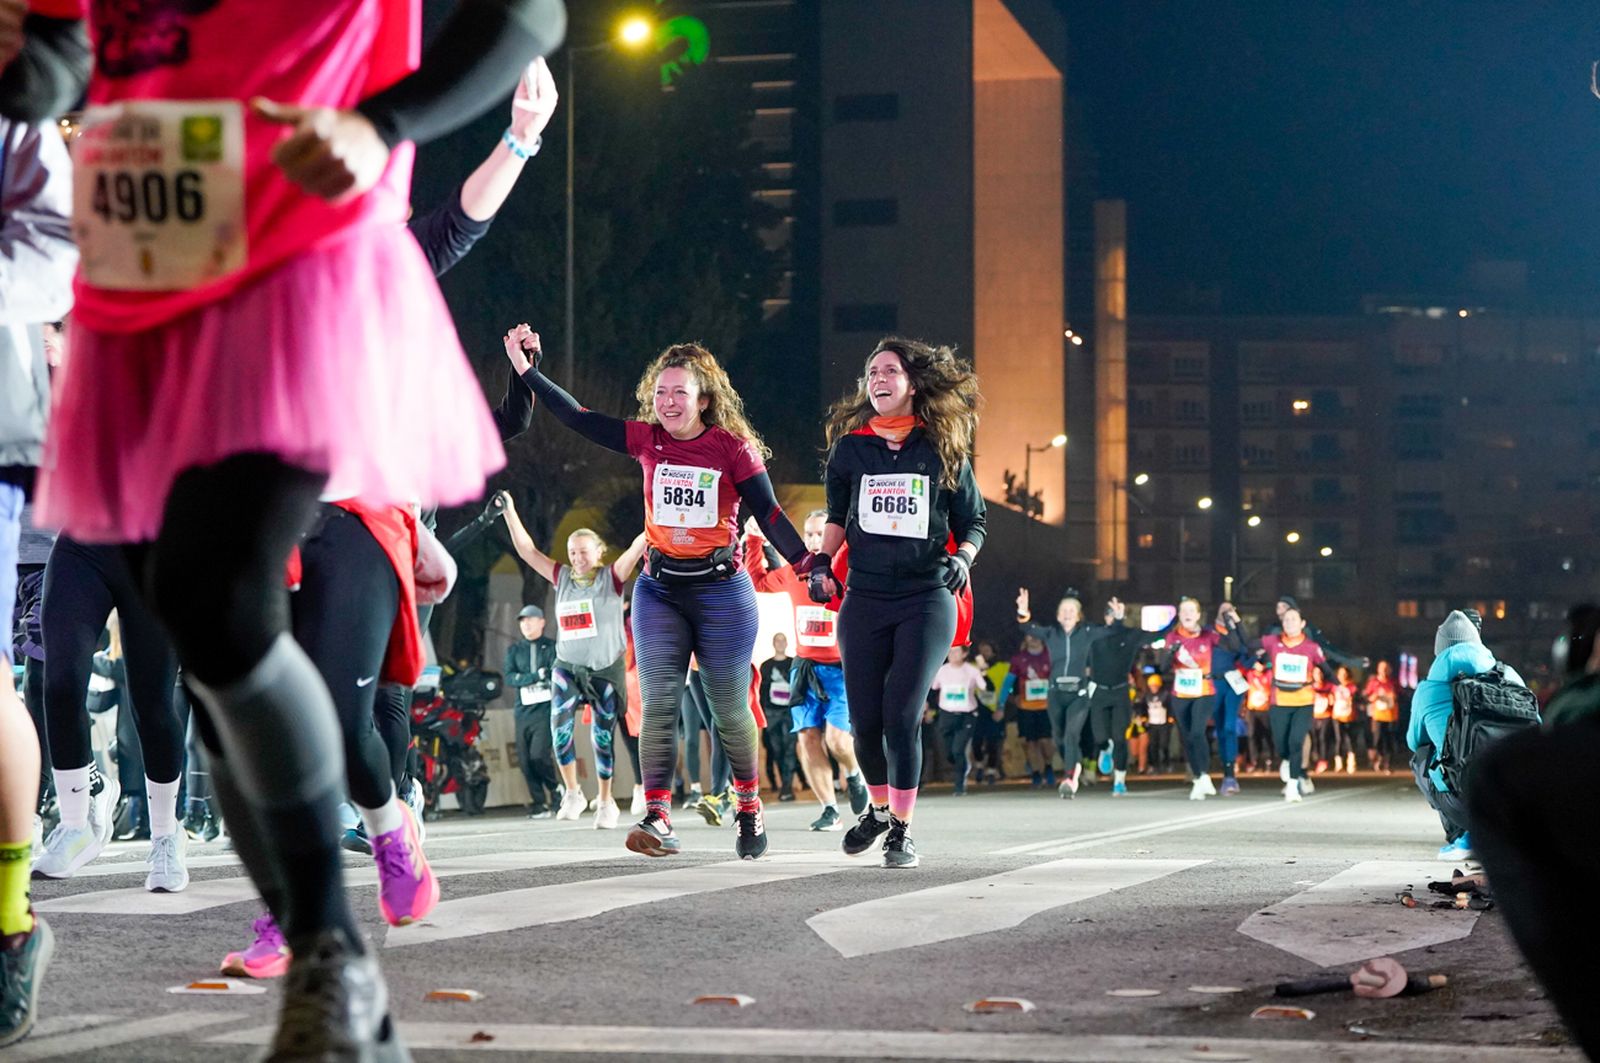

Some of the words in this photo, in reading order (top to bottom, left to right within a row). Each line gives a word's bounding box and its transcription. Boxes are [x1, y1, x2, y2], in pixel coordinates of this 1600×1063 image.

[93, 171, 204, 223] 4906
[663, 486, 705, 507] 5834
[872, 496, 918, 515] 6685
